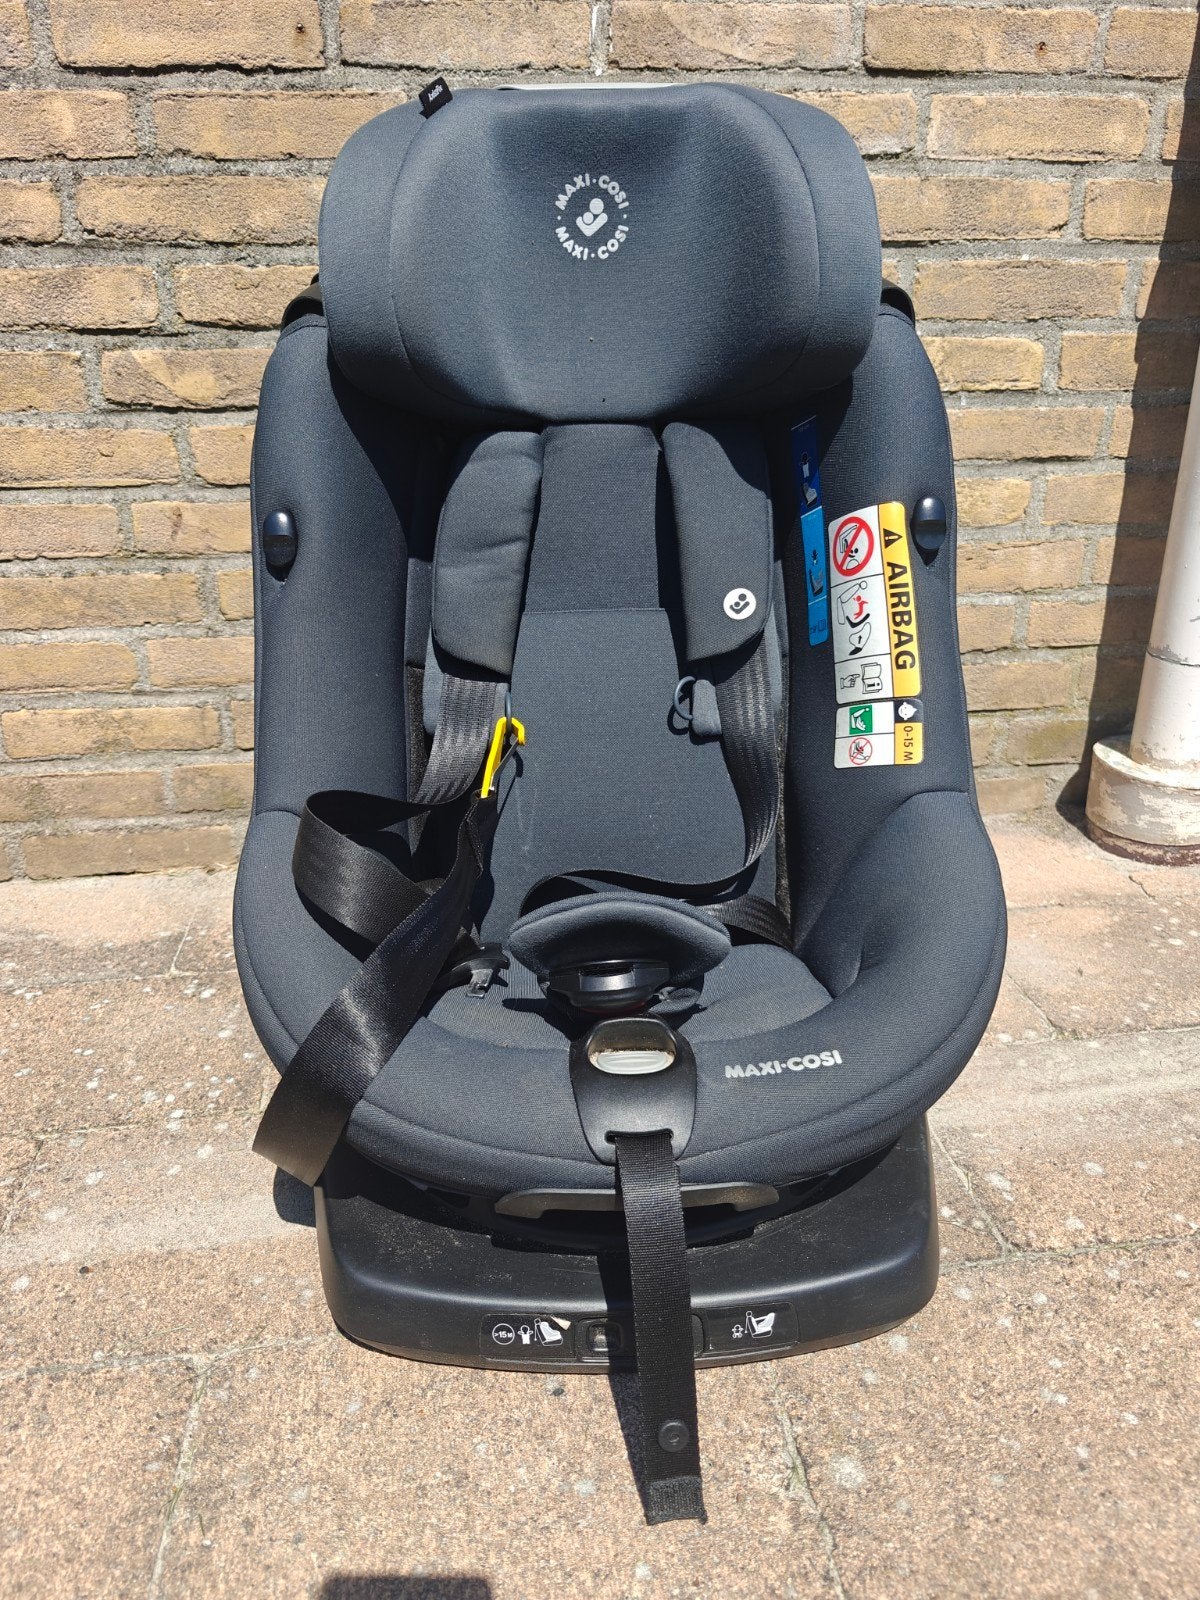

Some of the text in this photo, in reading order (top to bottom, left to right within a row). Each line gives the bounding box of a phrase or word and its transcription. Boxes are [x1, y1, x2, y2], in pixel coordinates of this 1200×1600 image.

[886, 561, 916, 670] AIRBAG
[903, 725, 914, 762] 0-15 M
